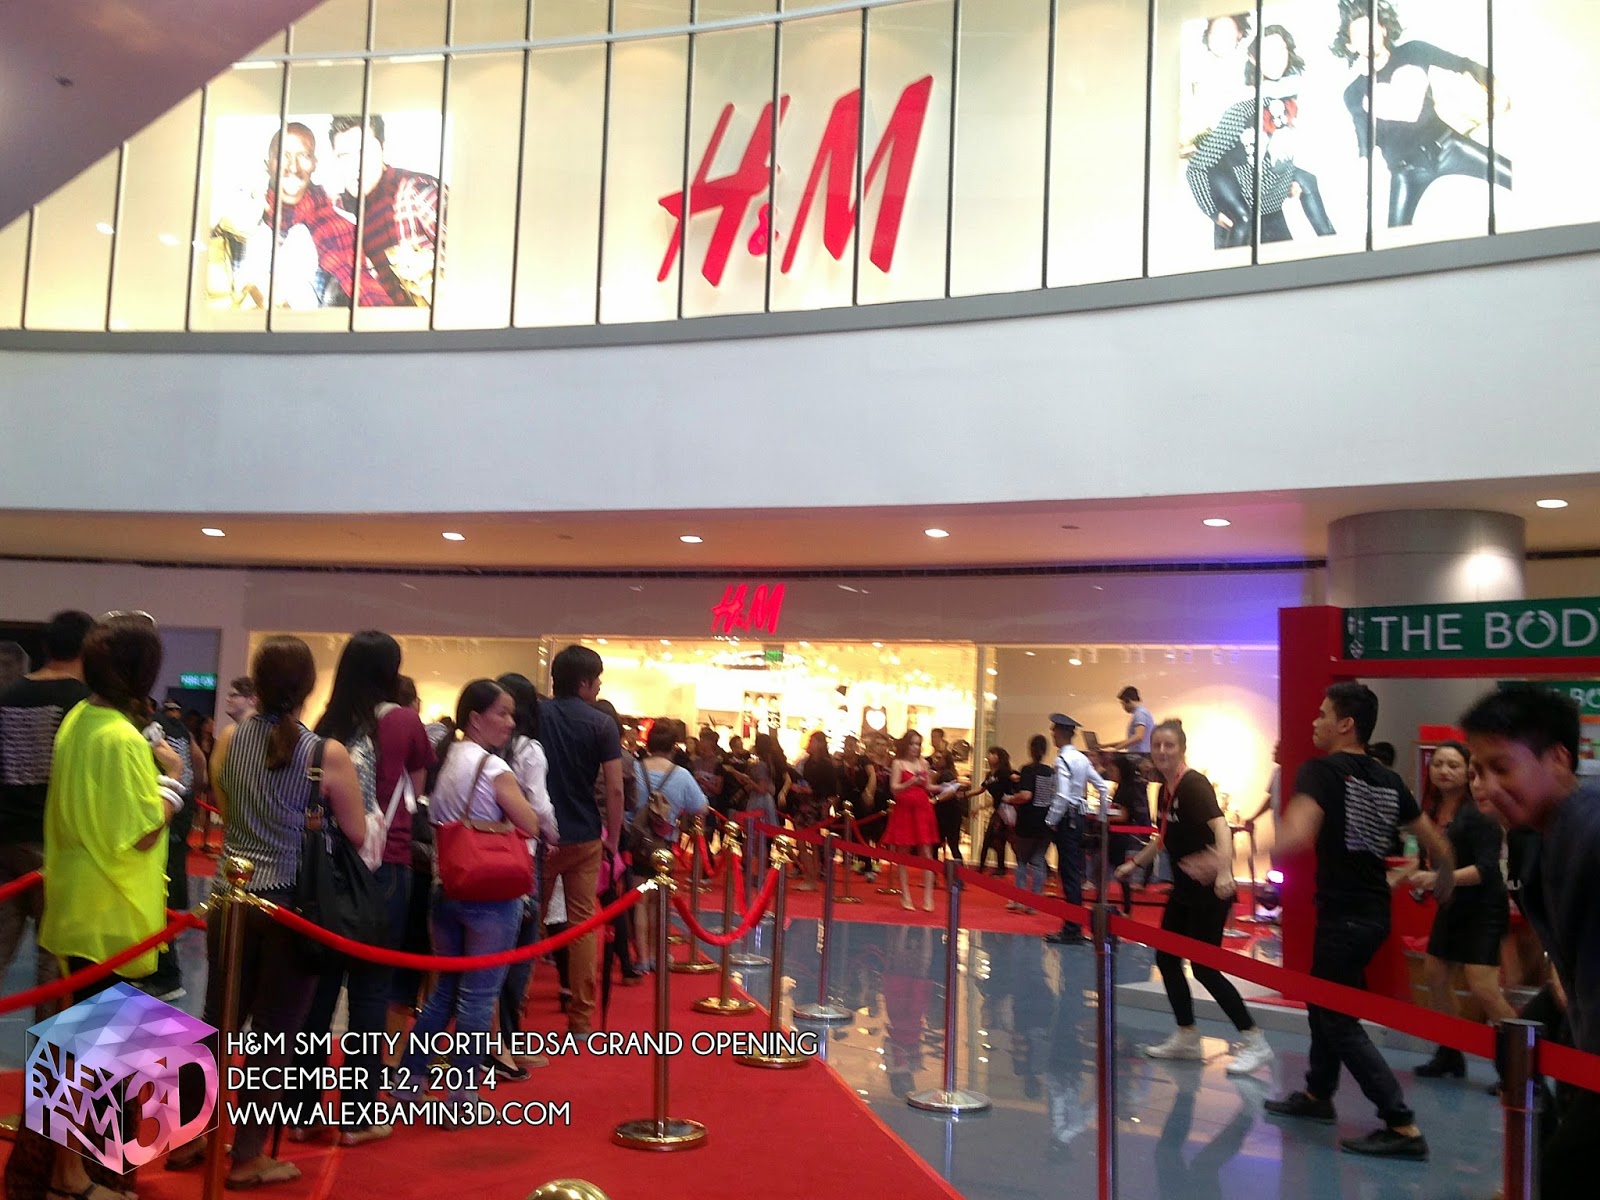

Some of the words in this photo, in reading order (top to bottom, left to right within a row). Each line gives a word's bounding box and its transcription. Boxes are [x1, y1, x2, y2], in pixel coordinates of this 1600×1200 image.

[657, 73, 933, 287] H&M
[711, 583, 786, 634] H&M
[1370, 612, 1464, 651] THE
[1485, 606, 1600, 649] BOD
